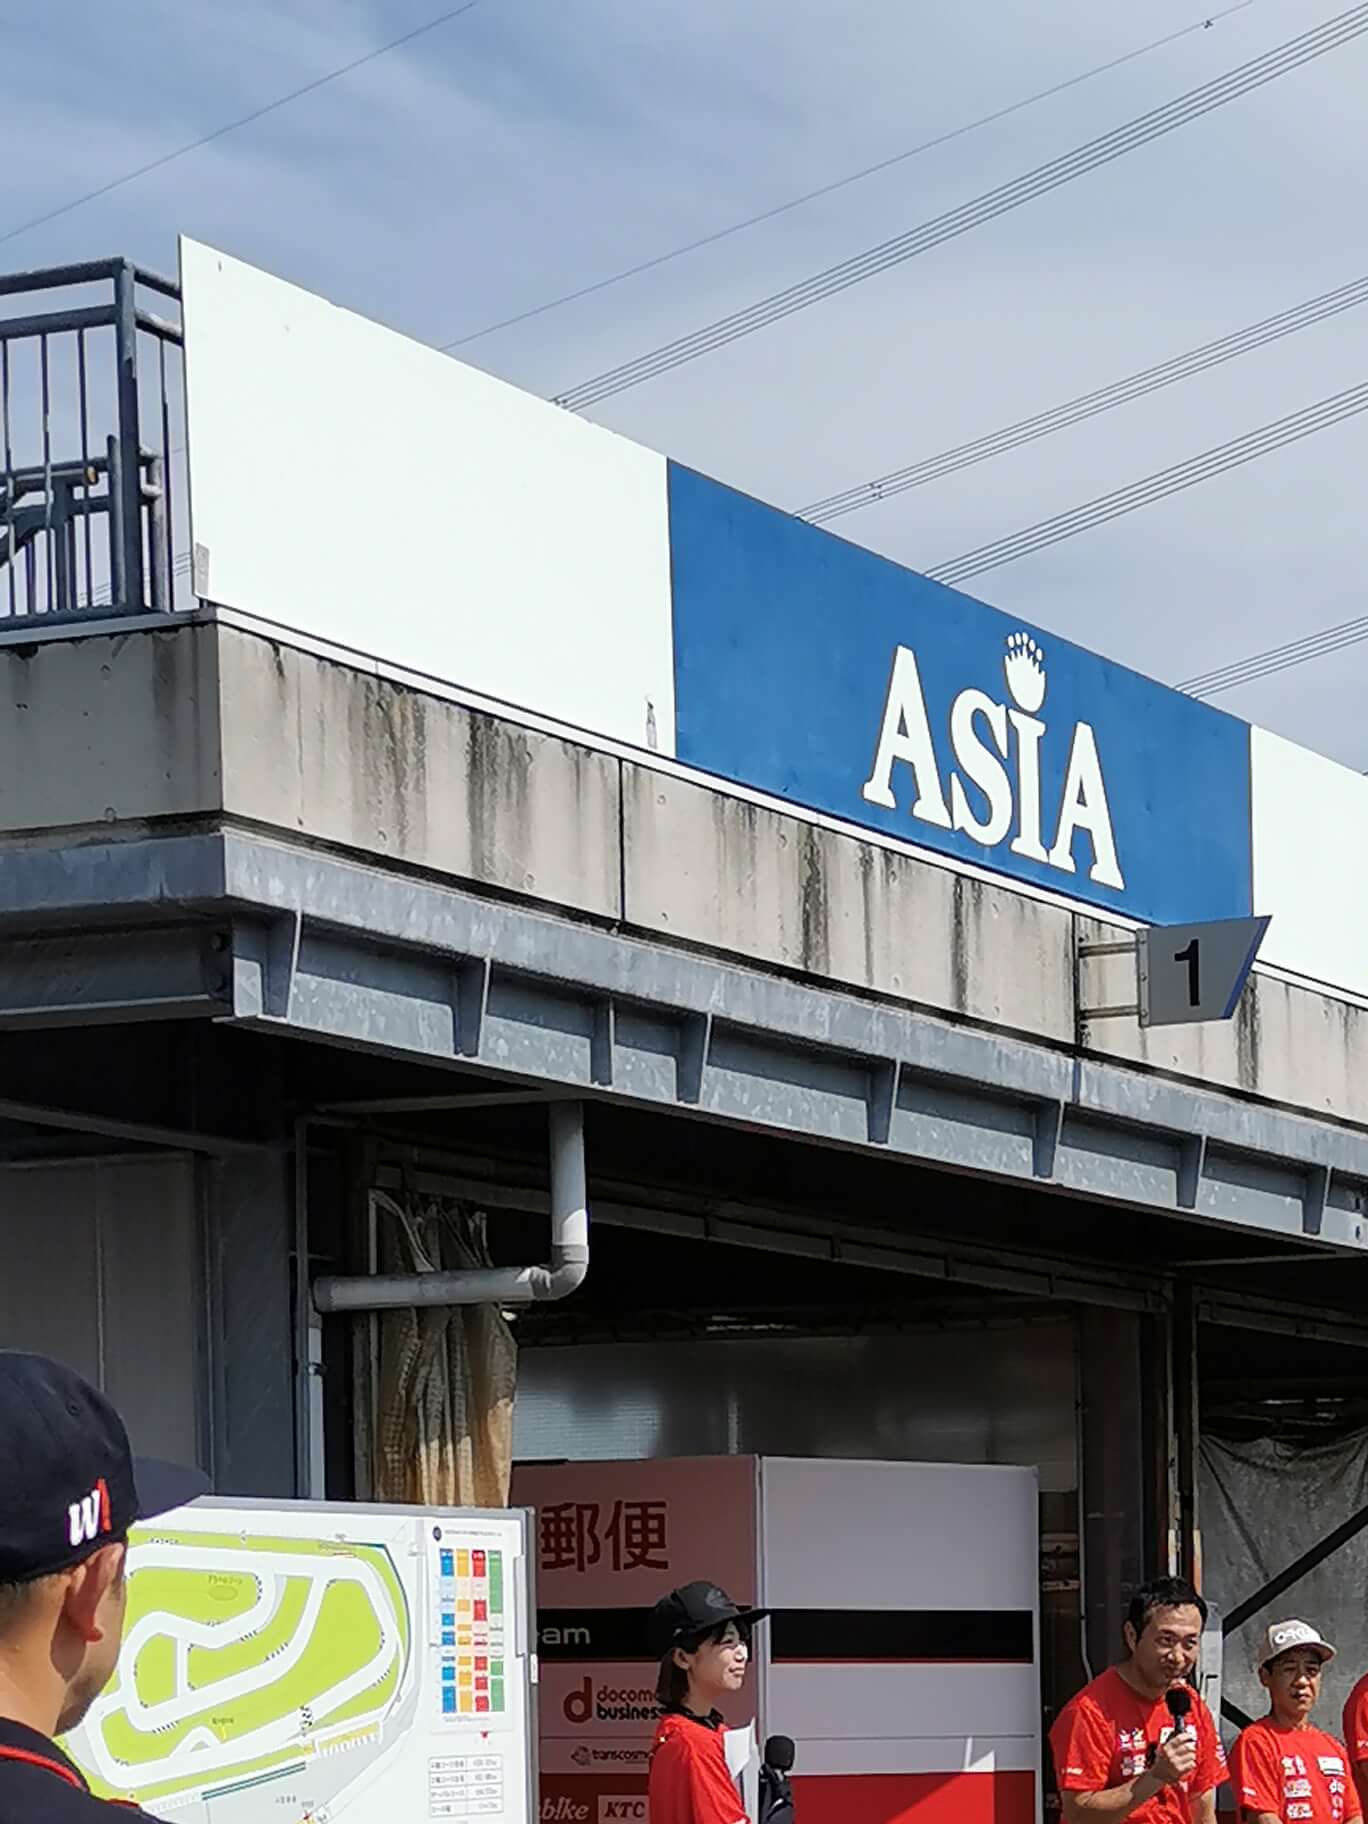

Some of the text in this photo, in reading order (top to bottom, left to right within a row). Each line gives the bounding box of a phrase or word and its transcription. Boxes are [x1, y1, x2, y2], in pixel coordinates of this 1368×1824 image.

[862, 632, 1126, 892] ASIA
[1173, 938, 1200, 1007] 1
[540, 1500, 669, 1572] 郵便
[605, 1802, 645, 1818] KTC
